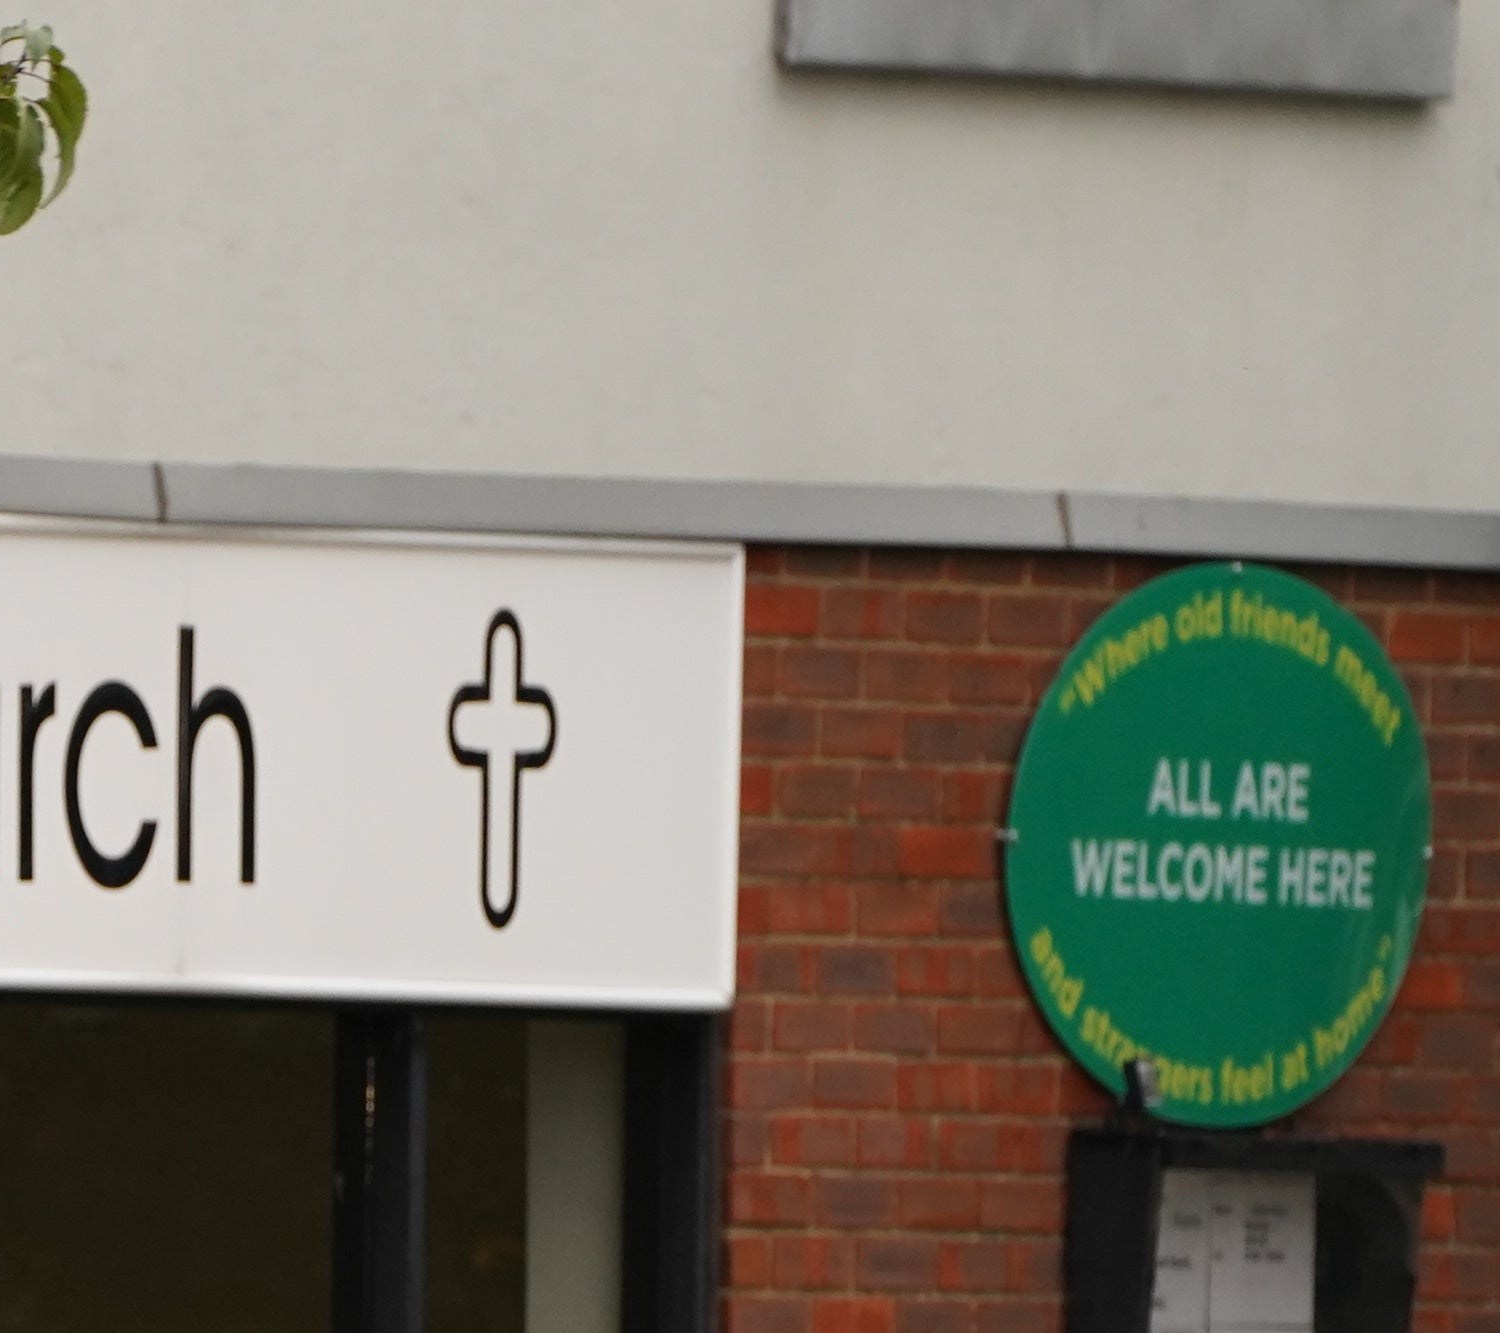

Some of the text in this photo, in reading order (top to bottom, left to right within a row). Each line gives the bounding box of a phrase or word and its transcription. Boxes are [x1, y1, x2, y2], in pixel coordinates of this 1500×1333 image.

[1174, 590, 1223, 642] old
[1229, 588, 1331, 668] friends
[1334, 644, 1402, 748] meet
[1148, 757, 1312, 822] ALL ARE
[1070, 836, 1375, 911] WELCOME HERE
[1029, 925, 1085, 1020] and
[1220, 1051, 1275, 1106] feel
[1281, 1040, 1310, 1091] at
